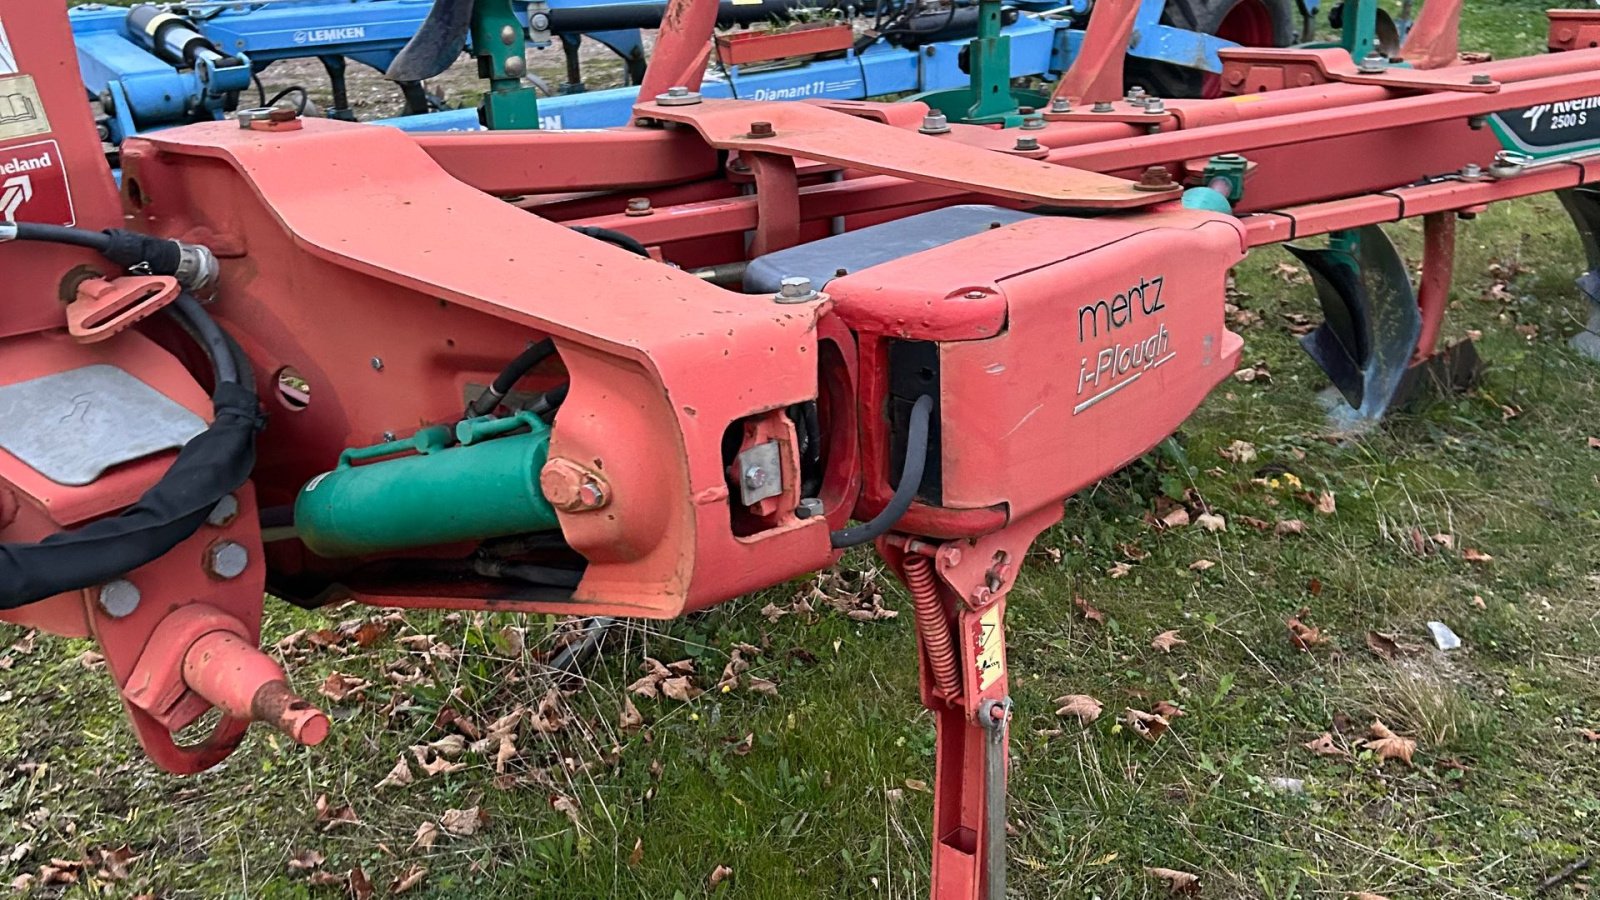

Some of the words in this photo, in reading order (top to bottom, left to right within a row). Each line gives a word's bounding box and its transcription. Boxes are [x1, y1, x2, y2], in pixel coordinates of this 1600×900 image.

[308, 27, 365, 41] LEMKEN
[754, 84, 811, 101] Diamant
[813, 81, 825, 94] 11
[1553, 96, 1600, 114] Kvern
[1550, 113, 1577, 129] 2500
[1578, 111, 1587, 125] S
[1078, 276, 1165, 342] mertz
[1077, 323, 1169, 394] i-Plough
